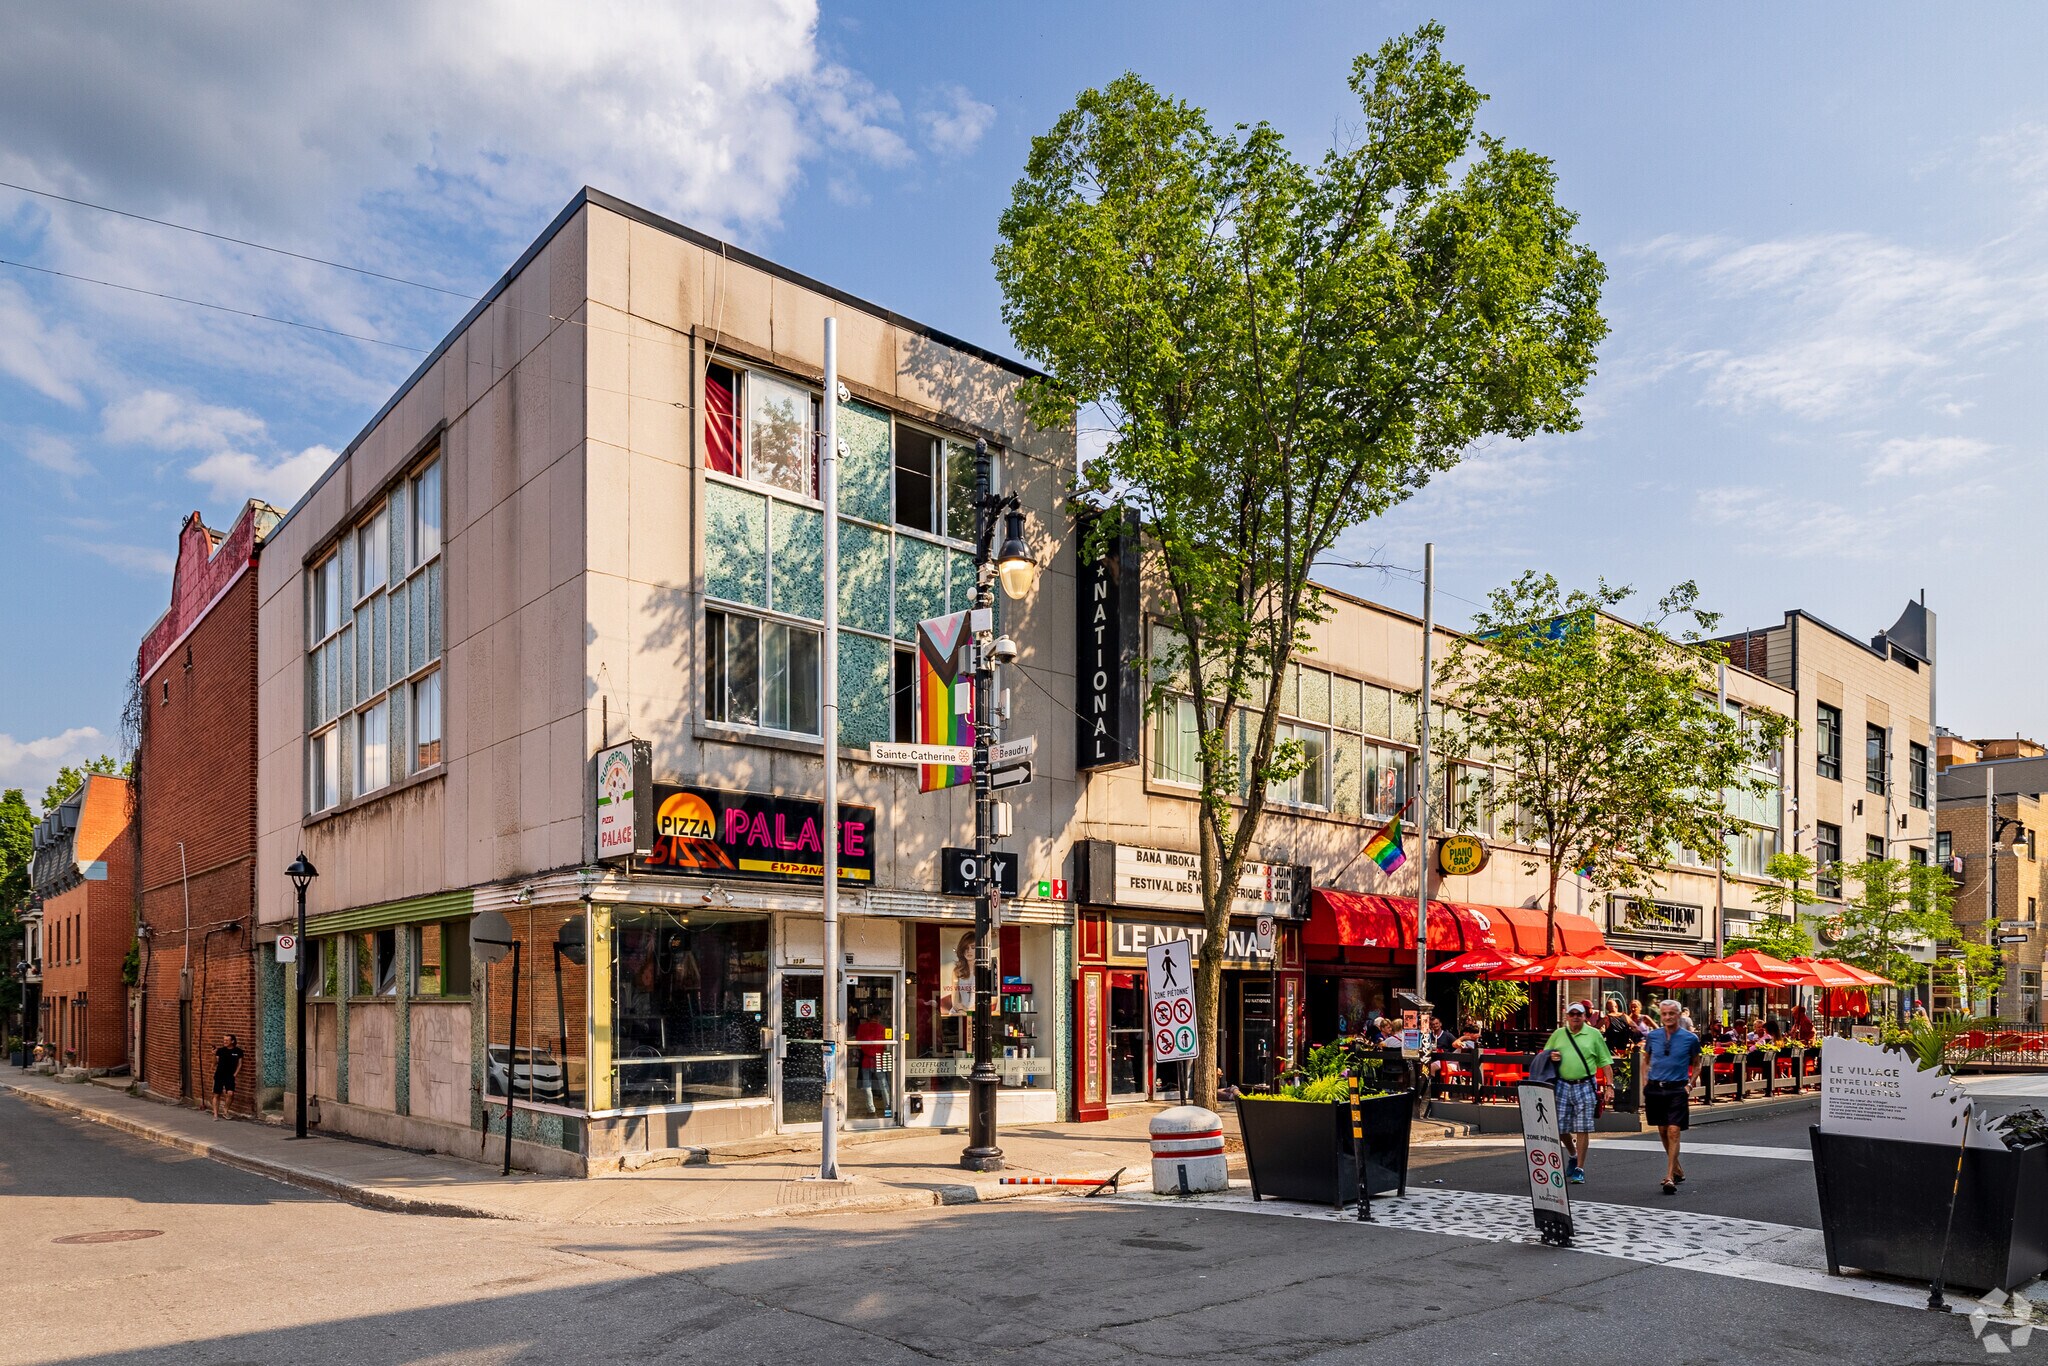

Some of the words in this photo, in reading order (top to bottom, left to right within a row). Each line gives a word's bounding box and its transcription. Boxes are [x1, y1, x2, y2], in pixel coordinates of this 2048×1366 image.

[1093, 580, 1108, 759] NATIONAL
[876, 749, 956, 762] Sainte-Catherine
[999, 744, 1029, 759] Beaudry
[602, 815, 614, 825] PIZZA
[661, 815, 712, 839] PIZZA
[601, 825, 632, 848] PALACE
[1446, 839, 1456, 849] LE
[1458, 837, 1476, 847] DATE
[1449, 847, 1472, 860] PIANO
[1453, 856, 1470, 865] BAR
[771, 862, 843, 876] EMPANAA
[1136, 850, 1162, 864] BANA
[1165, 853, 1196, 867] MBOKA
[1239, 861, 1258, 875] HOW
[1262, 866, 1272, 876] 30
[1274, 867, 1291, 878] JUIN
[1447, 864, 1456, 872] LE
[1458, 861, 1476, 873] DATE
[1130, 877, 1174, 892] FESTIVAL
[1176, 884, 1193, 893] DES
[1233, 887, 1262, 899] FRIQUE
[1263, 891, 1272, 901] 13
[1274, 892, 1291, 903] JUIL
[1266, 879, 1271, 888] 8
[1274, 880, 1290, 890] JUIL
[1118, 924, 1147, 952] LE
[1153, 926, 1272, 958] NTNA
[1154, 991, 1166, 1000] ZONE
[1167, 986, 1189, 998] PIÉTONNE
[1088, 991, 1097, 1057] NATIONAL
[1287, 994, 1295, 1047] NATIONAL
[1287, 1048, 1295, 1062] LE
[1088, 1059, 1097, 1074] LE
[1830, 1065, 1844, 1074] LE
[1848, 1066, 1900, 1078] VILLAGE
[1829, 1078, 1860, 1086] ENTRE
[1863, 1080, 1900, 1089] LIANES
[1844, 1088, 1901, 1098] PAILLETTES
